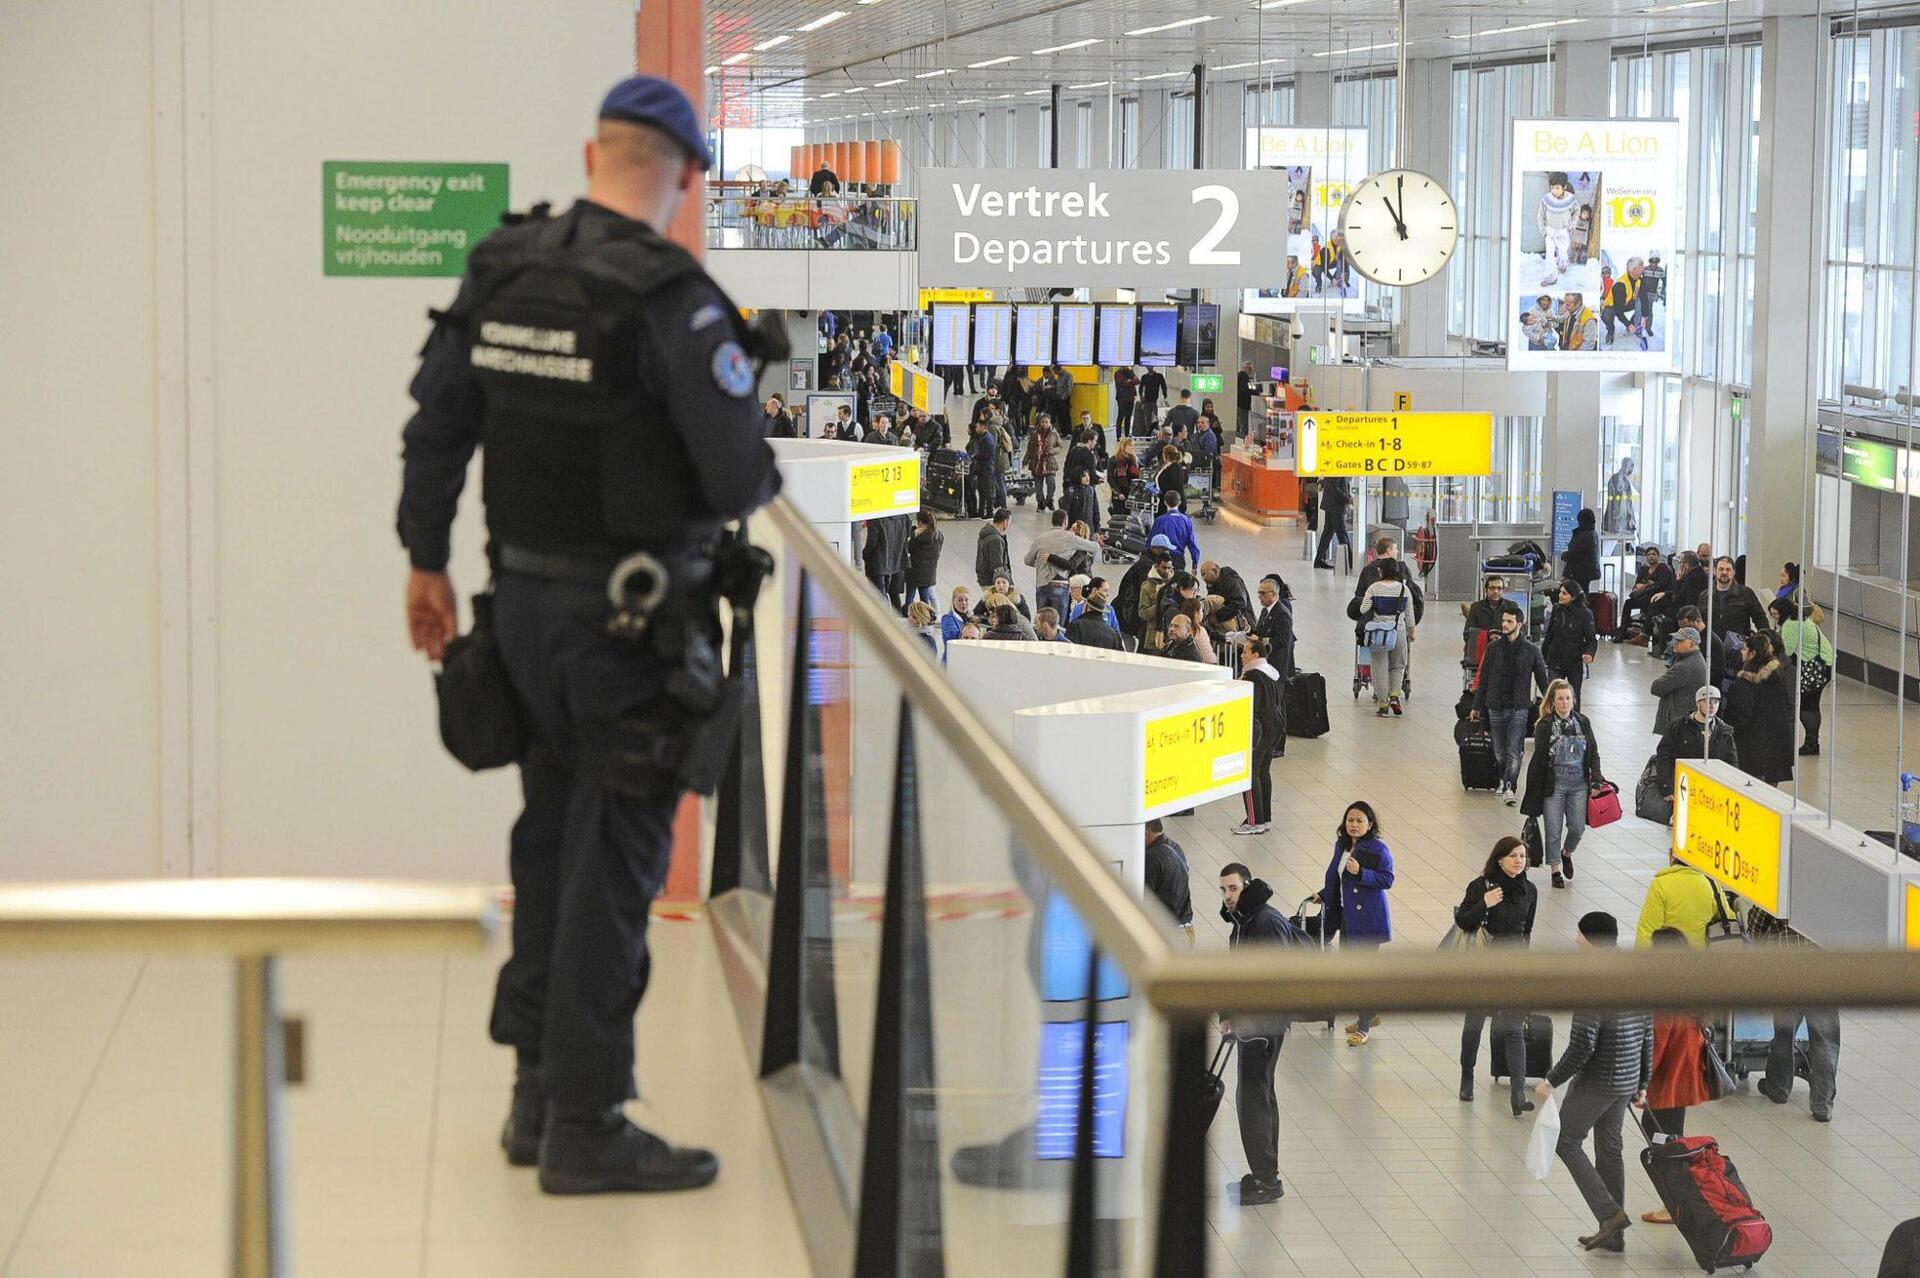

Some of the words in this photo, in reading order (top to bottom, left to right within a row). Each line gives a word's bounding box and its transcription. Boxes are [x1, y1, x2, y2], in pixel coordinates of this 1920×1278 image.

[1262, 136, 1287, 153] Be
[1294, 136, 1307, 152] A
[1535, 131, 1568, 153] Be
[1578, 131, 1596, 152] A
[1606, 131, 1658, 153] Lion
[335, 172, 442, 195] Emergency
[446, 173, 485, 191] exit
[335, 193, 384, 215] keep
[387, 193, 436, 212] clear
[952, 182, 1110, 218] Vertrek
[1606, 196, 1656, 228] 100
[335, 226, 467, 249] Nooduitgang
[952, 231, 1171, 272] Departures
[1188, 184, 1241, 265] 2
[335, 246, 443, 269] vrijhouden
[1399, 395, 1407, 410] F
[1336, 415, 1388, 425] Departures
[1391, 418, 1398, 430] 1
[1336, 440, 1376, 449] Check-in
[1378, 438, 1402, 451] 1-8
[881, 467, 890, 482] 12
[893, 466, 902, 481] 13
[1336, 461, 1362, 469] Gates
[1365, 459, 1374, 471] B
[1377, 459, 1387, 471] C
[1394, 459, 1405, 471] D
[1407, 461, 1432, 469] 59-87
[1192, 716, 1206, 745] 15
[1211, 712, 1225, 739] 16
[1145, 775, 1179, 795] Economy
[1699, 788, 1723, 812] Check-in
[1725, 797, 1740, 832] 1-8
[1697, 835, 1714, 859] Gates
[1714, 840, 1721, 869] B
[1723, 846, 1730, 875] C
[1733, 851, 1741, 880] D
